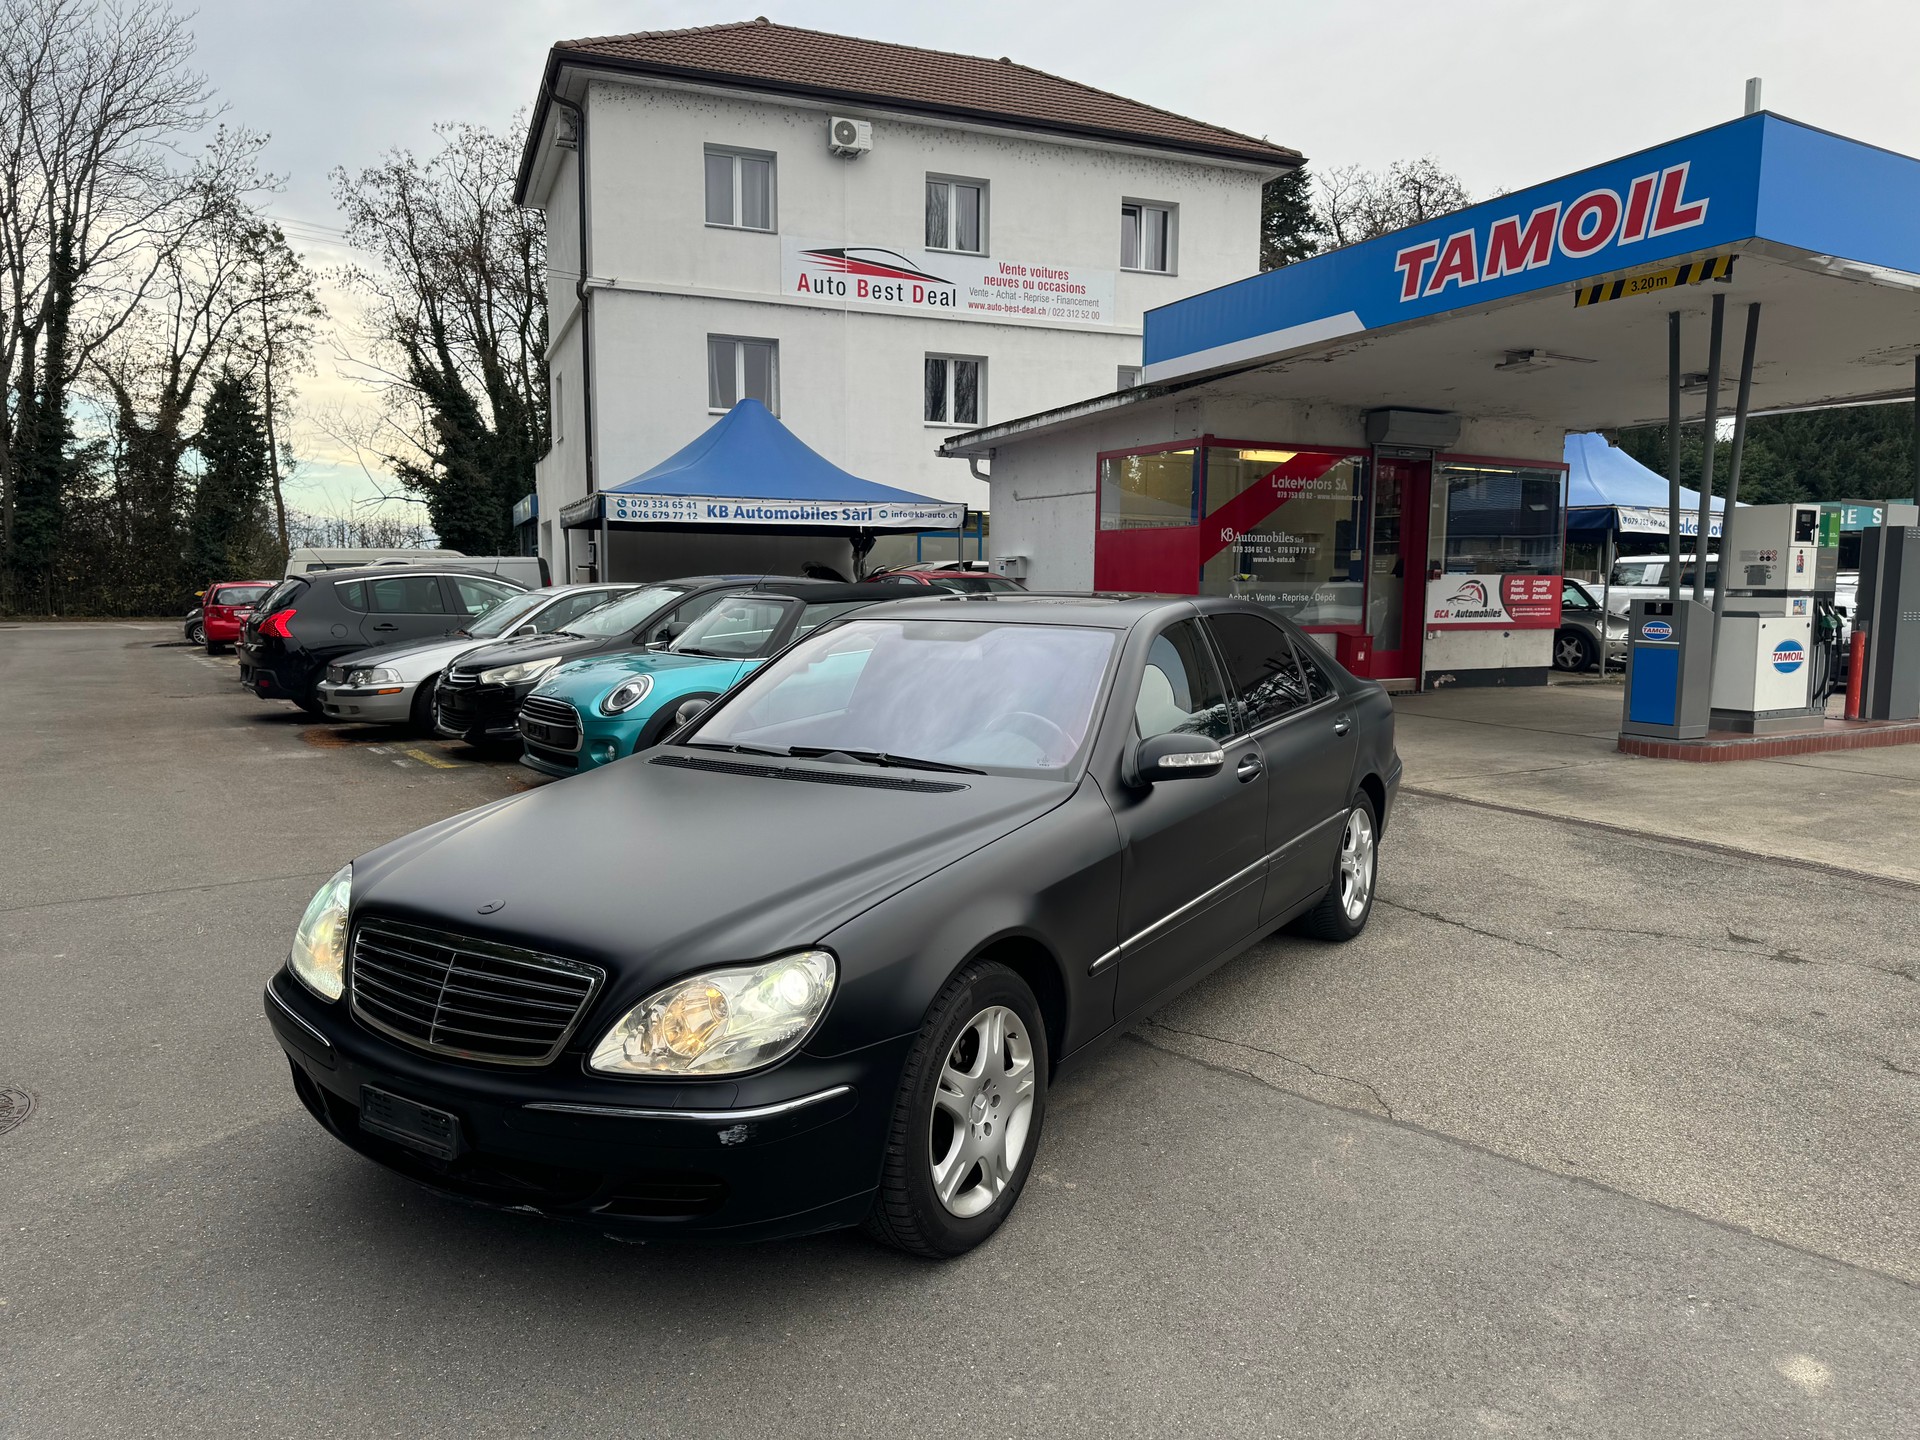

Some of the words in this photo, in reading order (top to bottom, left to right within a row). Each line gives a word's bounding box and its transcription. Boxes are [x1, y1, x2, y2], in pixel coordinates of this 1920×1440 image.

[1394, 161, 1710, 303] TAMOIL
[999, 262, 1027, 276] Vente
[1030, 266, 1069, 280] voitures
[797, 273, 846, 296] Auto
[857, 279, 903, 302] Best
[912, 284, 957, 307] Deal
[984, 275, 1019, 288] neuves
[1022, 279, 1034, 290] ou
[1038, 281, 1086, 294] occasions
[1631, 277, 1655, 292] 3.20
[1656, 276, 1668, 286] m
[969, 287, 989, 297] Vente
[996, 290, 1017, 300] Achat
[1024, 292, 1050, 303] Reprise
[1056, 295, 1100, 307] Financement
[968, 301, 1047, 315] www.auto-best-deal.ch
[1052, 307, 1064, 317] 022
[1066, 308, 1079, 318] 312
[1081, 310, 1090, 319] 52
[1091, 311, 1100, 320] 00
[1272, 474, 1332, 490] LakeMotors
[1335, 478, 1348, 491] SA
[631, 499, 649, 508] 079
[652, 500, 669, 509] 334
[672, 500, 684, 509] 65
[686, 501, 698, 510] 41
[707, 504, 728, 518] KB
[733, 505, 838, 521] Automobiles
[842, 507, 873, 521] Sàrl
[631, 510, 649, 519] 076
[652, 510, 670, 519] 679
[673, 511, 684, 519] 77
[687, 512, 698, 520] 12
[891, 510, 958, 519] info@kb-auto.ch
[1810, 528, 1815, 540] 1
[1255, 593, 1276, 602] Vente
[1282, 592, 1310, 603] Reprise
[1315, 592, 1336, 603] Dépôt
[1433, 609, 1449, 618] GCA
[1454, 608, 1502, 619] Automobiles
[1643, 627, 1671, 635] TAMOIL
[1772, 651, 1804, 662] TAMOIL
